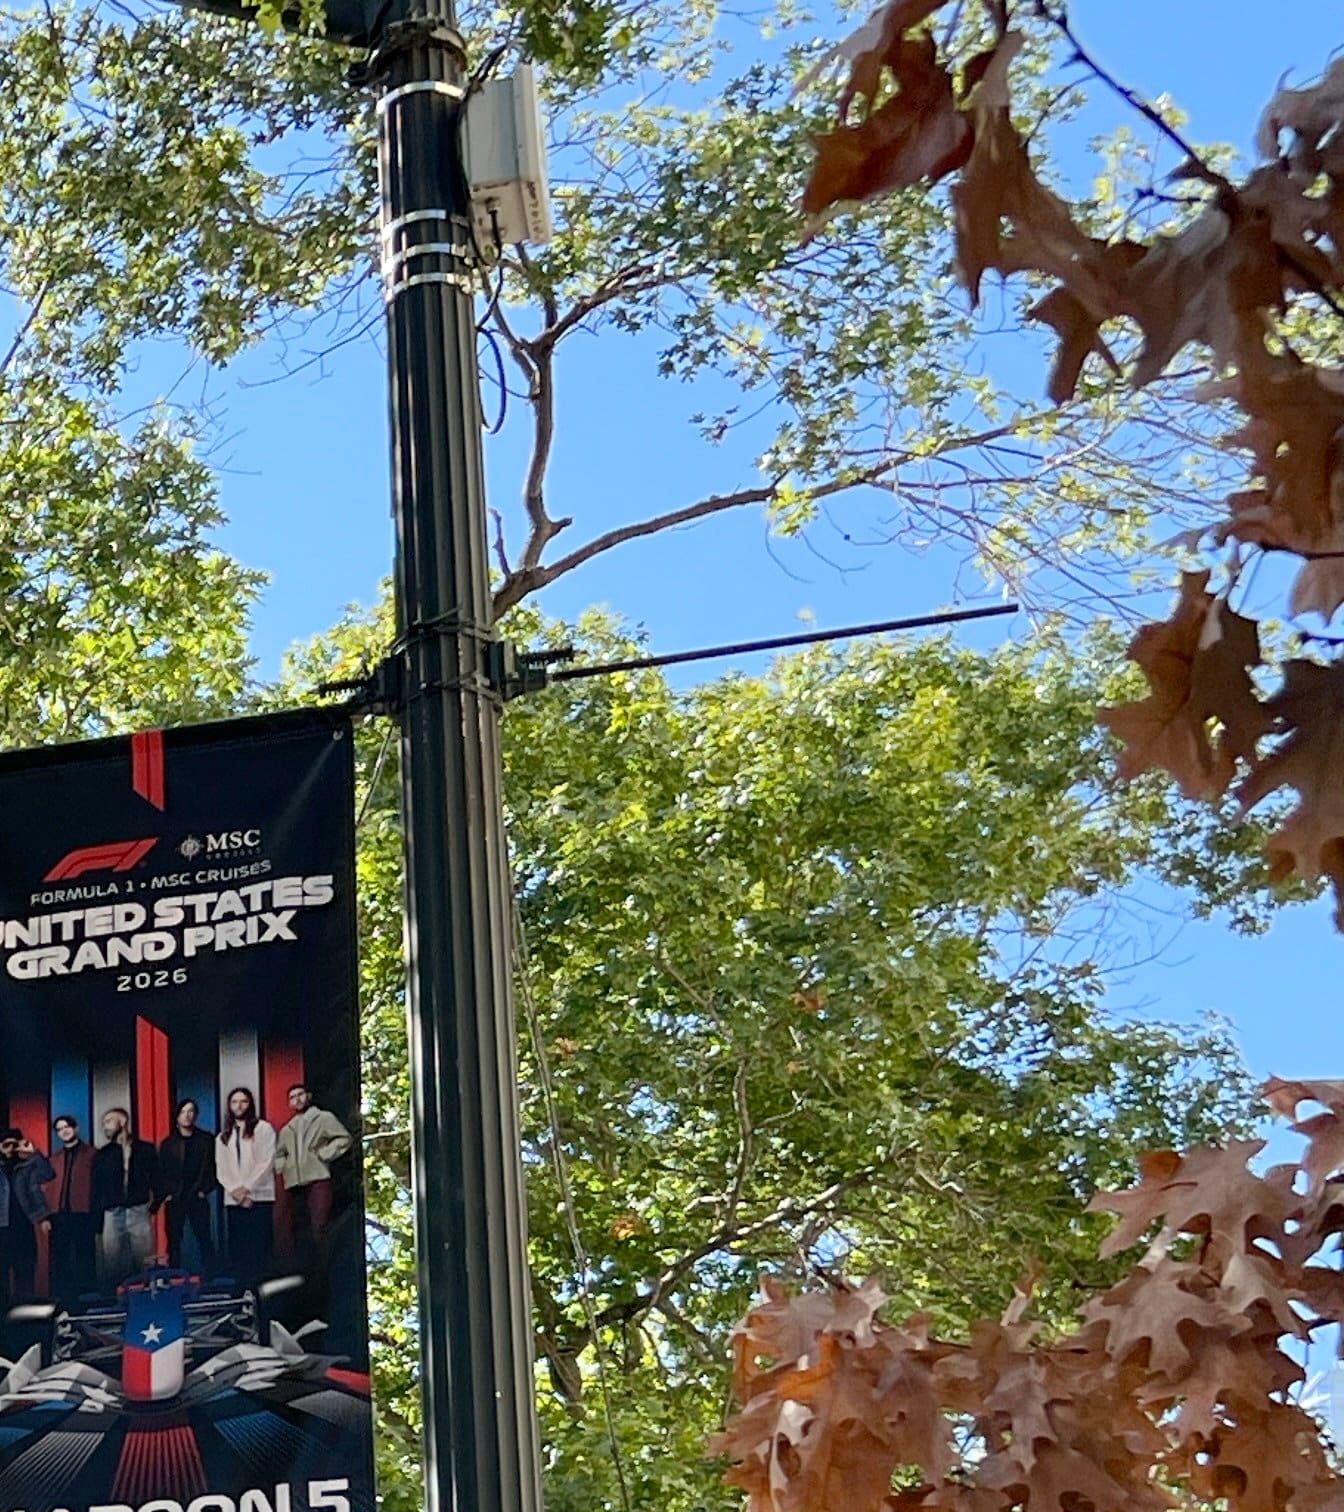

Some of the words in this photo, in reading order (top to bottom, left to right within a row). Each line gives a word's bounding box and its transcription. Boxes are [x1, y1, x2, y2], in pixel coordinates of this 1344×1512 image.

[206, 829, 261, 853] MSC
[30, 882, 119, 907] FORMULA
[126, 879, 135, 893] 1
[151, 872, 191, 889] MSC
[195, 859, 272, 883] CRUISES
[154, 875, 335, 929] STATES
[6, 933, 176, 981] GRAND
[183, 910, 298, 958] PRIX
[116, 967, 188, 992] 2026
